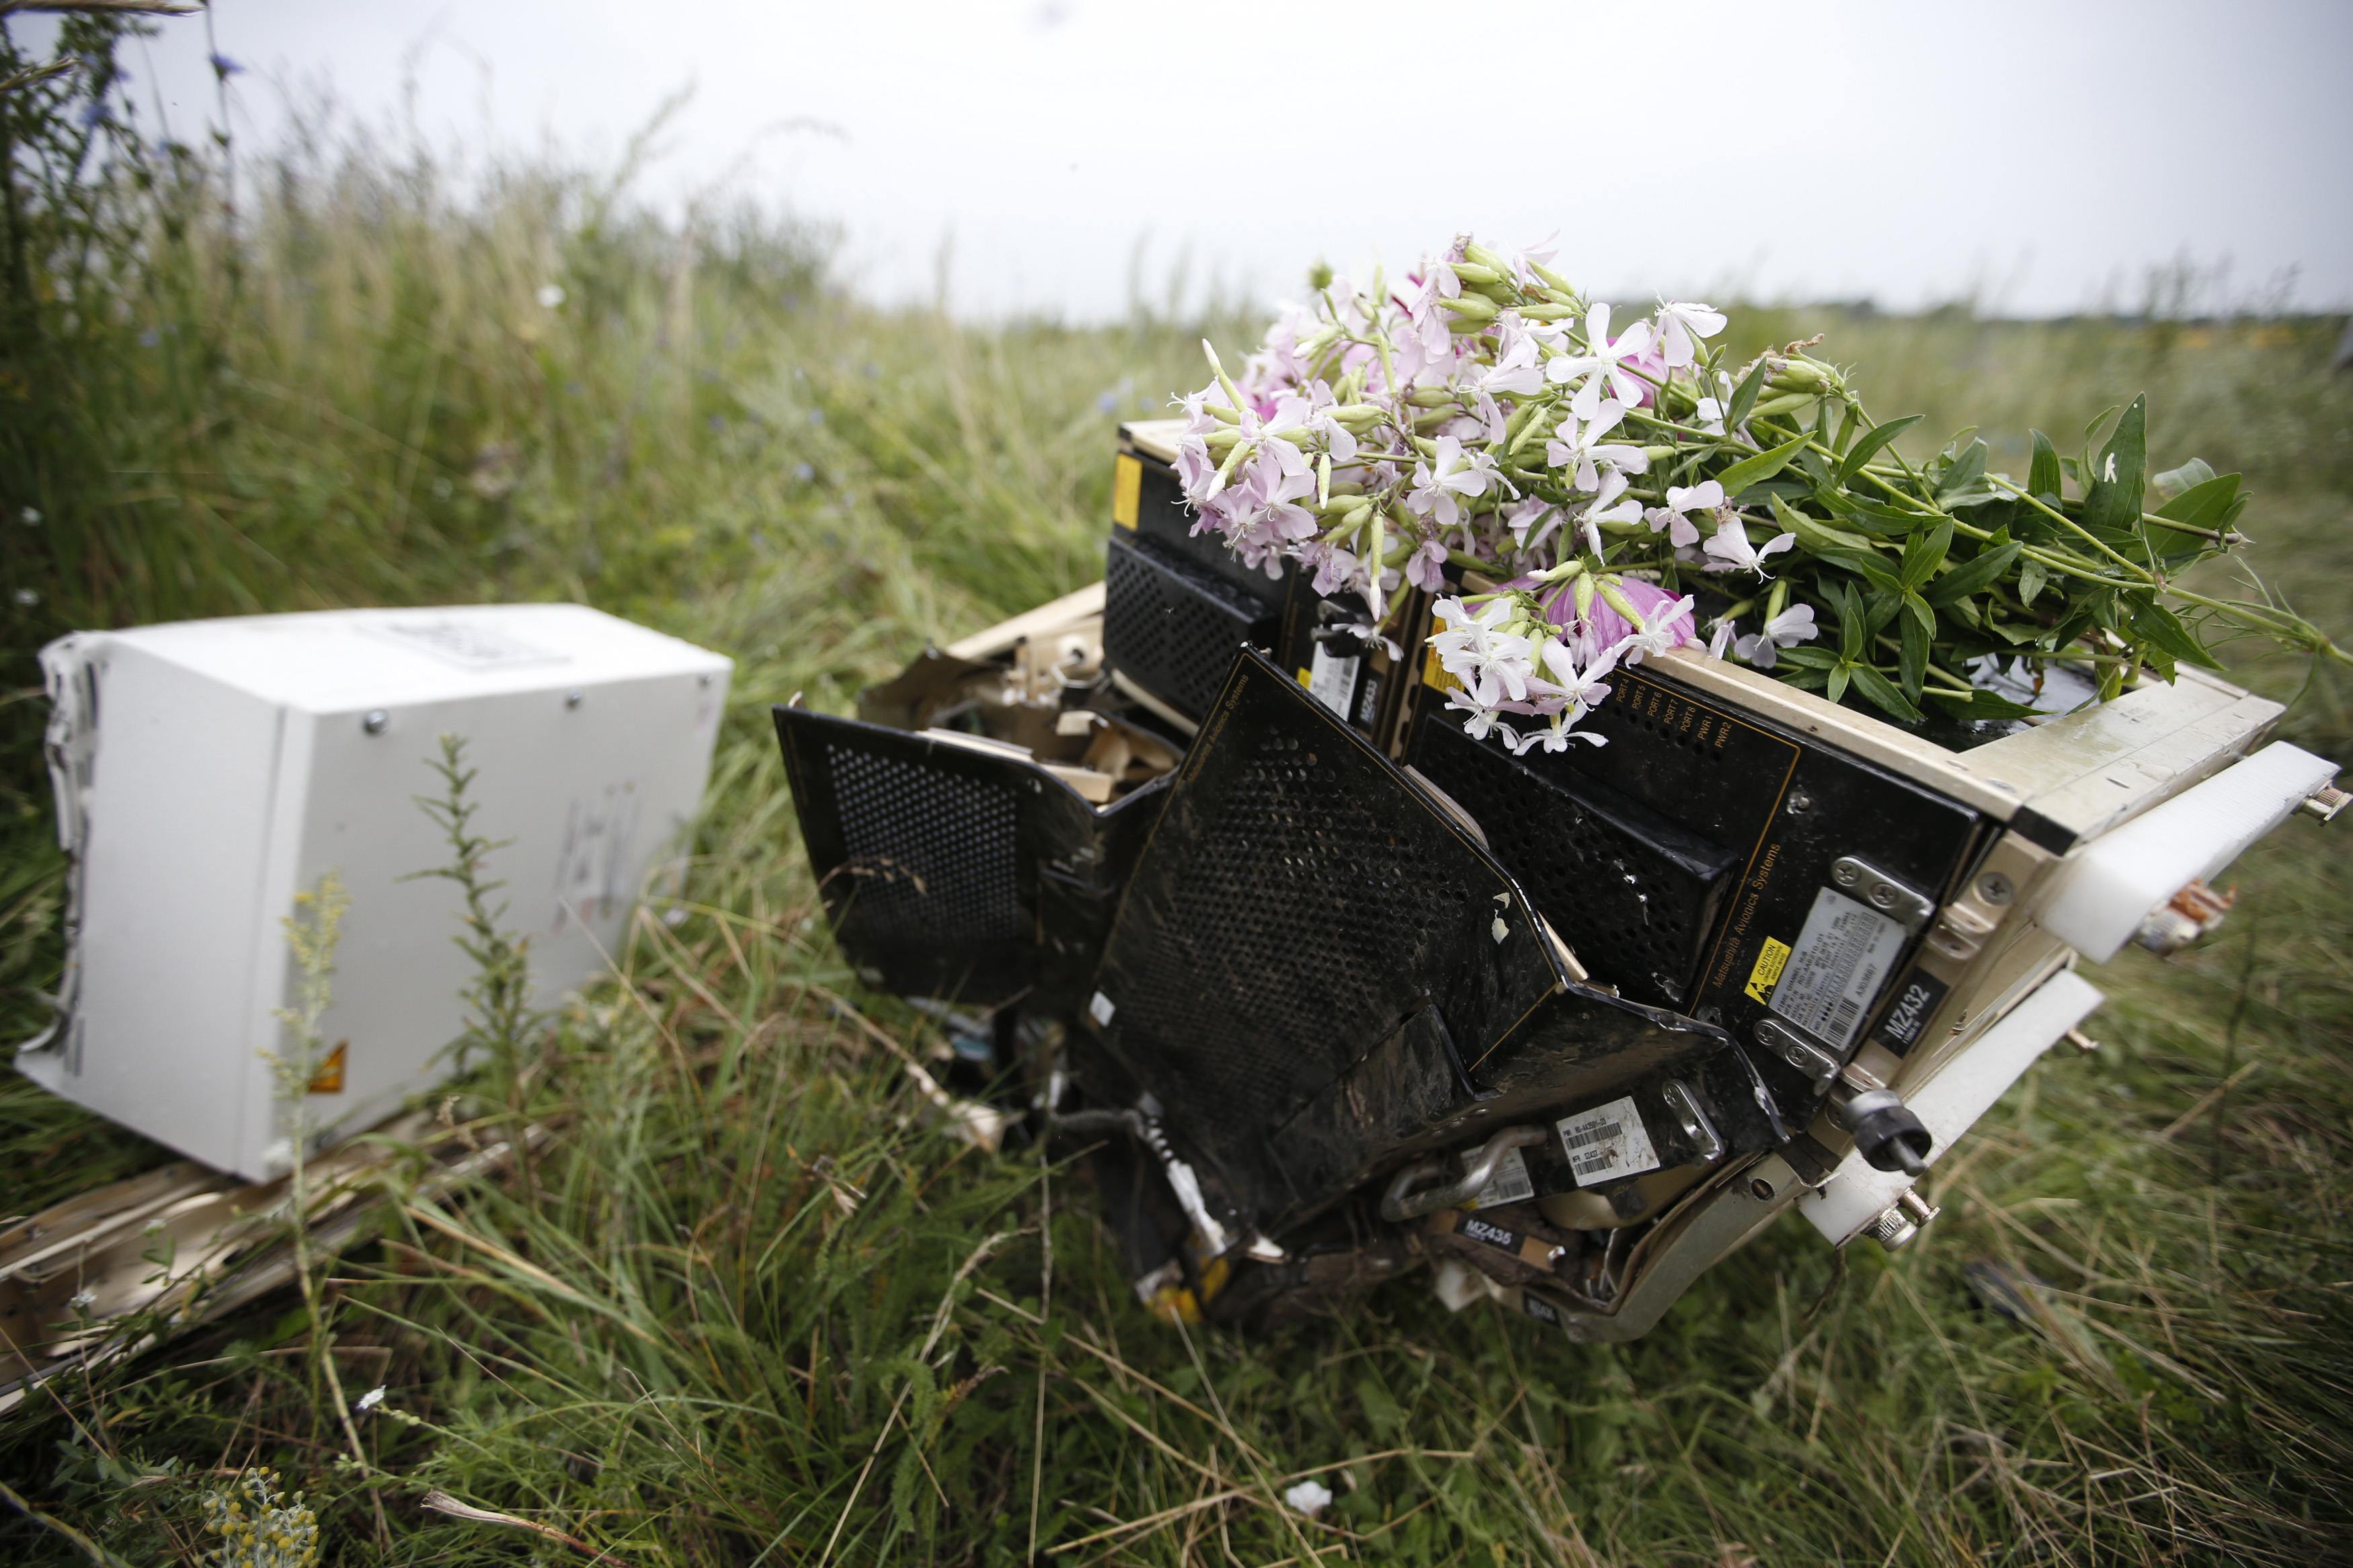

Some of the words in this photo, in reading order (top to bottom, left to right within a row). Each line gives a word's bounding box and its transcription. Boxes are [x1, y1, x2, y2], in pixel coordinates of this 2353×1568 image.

[1208, 710, 1229, 743] Avionics
[1226, 674, 1248, 709] Systems
[1713, 937, 1741, 988] Matsushita
[1734, 893, 1759, 935] Avionics
[1752, 843, 1780, 890] Systems
[1757, 944, 1776, 976] CAUTION
[1785, 965, 1802, 992] CHANNEL
[1798, 950, 1808, 963] HUB
[1884, 983, 1931, 1040] MZ432
